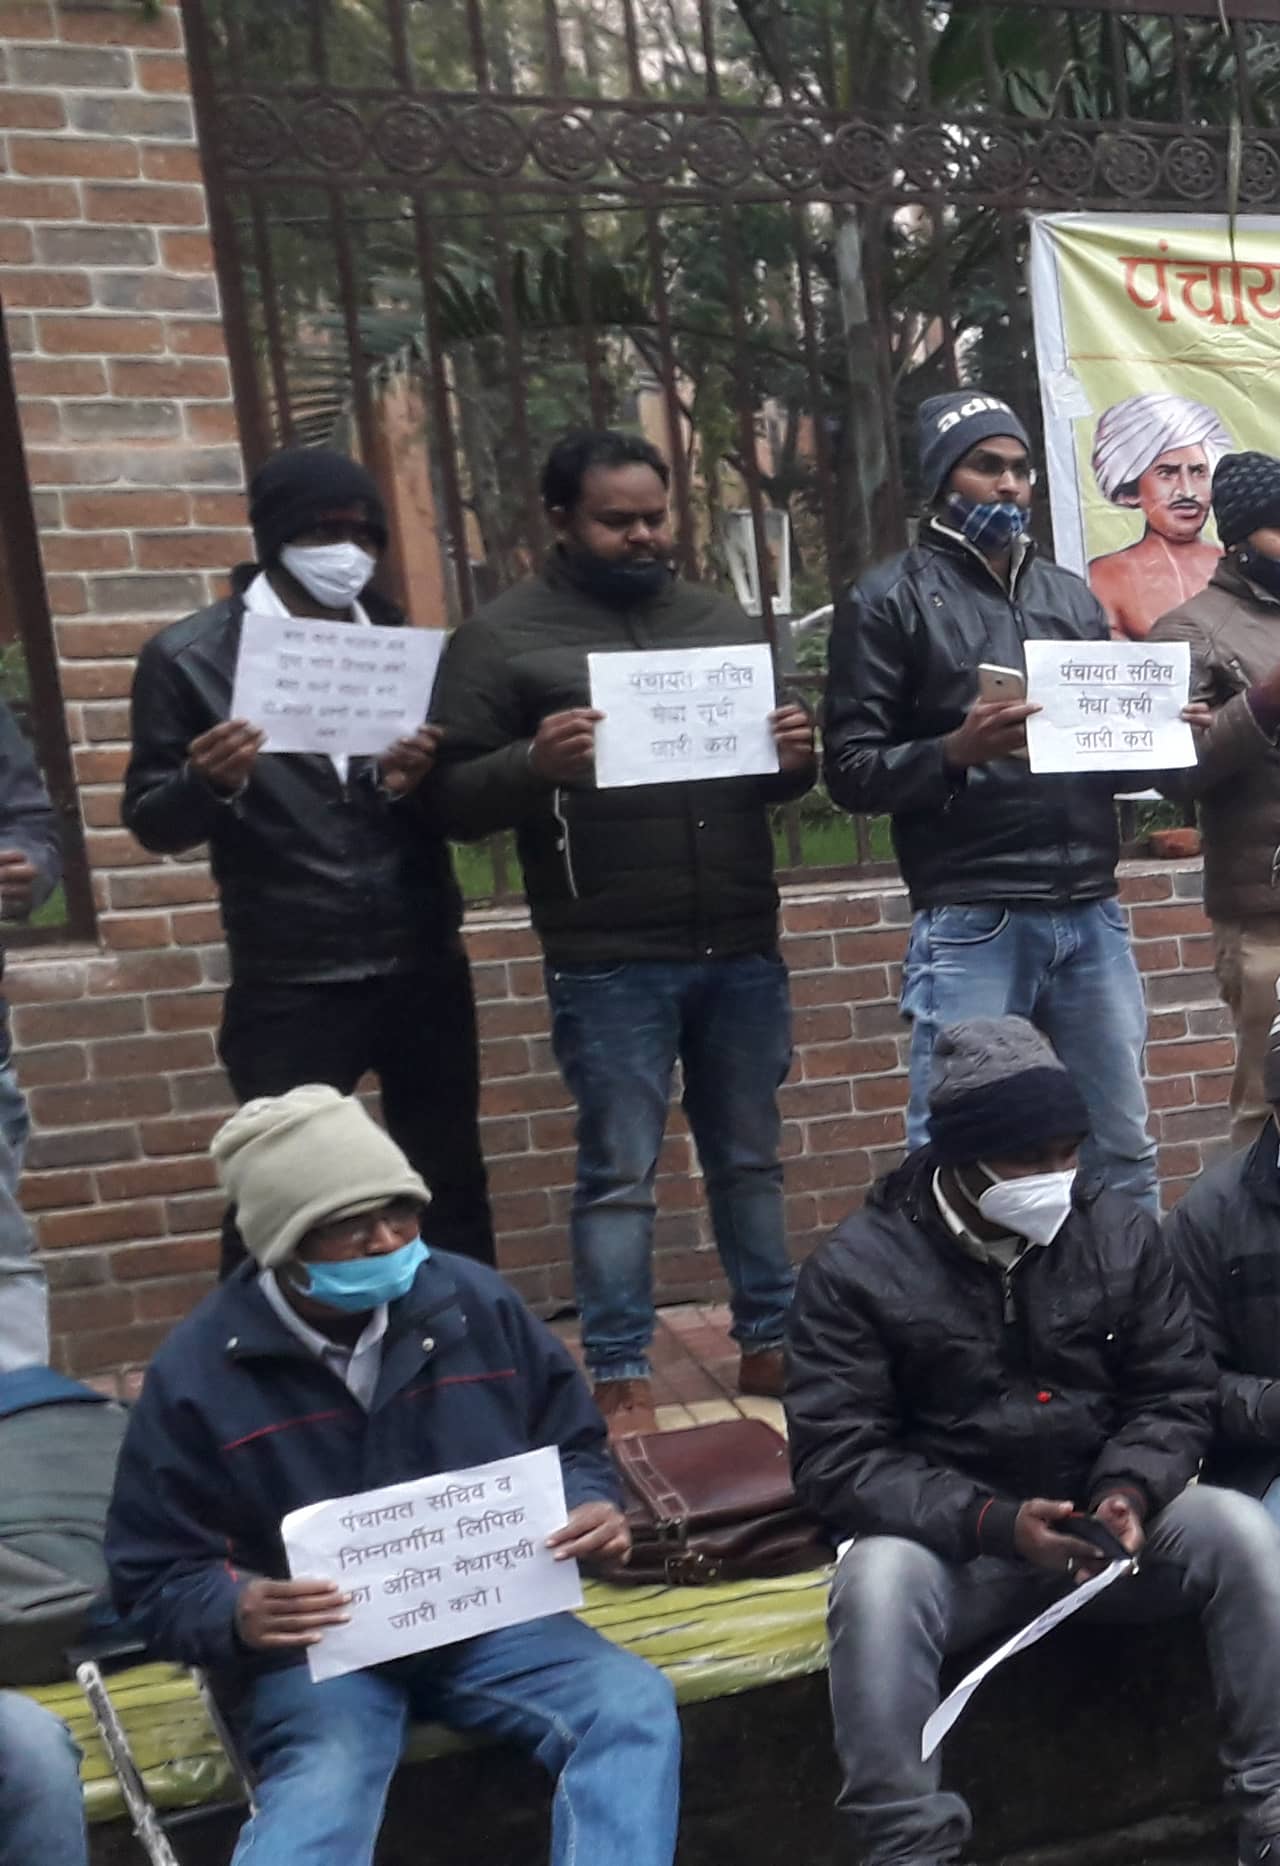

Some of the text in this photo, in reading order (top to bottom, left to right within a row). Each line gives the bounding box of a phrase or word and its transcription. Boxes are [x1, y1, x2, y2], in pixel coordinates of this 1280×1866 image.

[1059, 658, 1174, 681] पंचायत सचिव
[1117, 691, 1152, 718] सूची
[1075, 726, 1112, 749] जारी
[340, 1475, 513, 1533] पंचायत सचिव व
[340, 1507, 525, 1570] निम्नवर्गीय लिपिक
[384, 1566, 443, 1596] अंतिम
[389, 1603, 437, 1630] जारी
